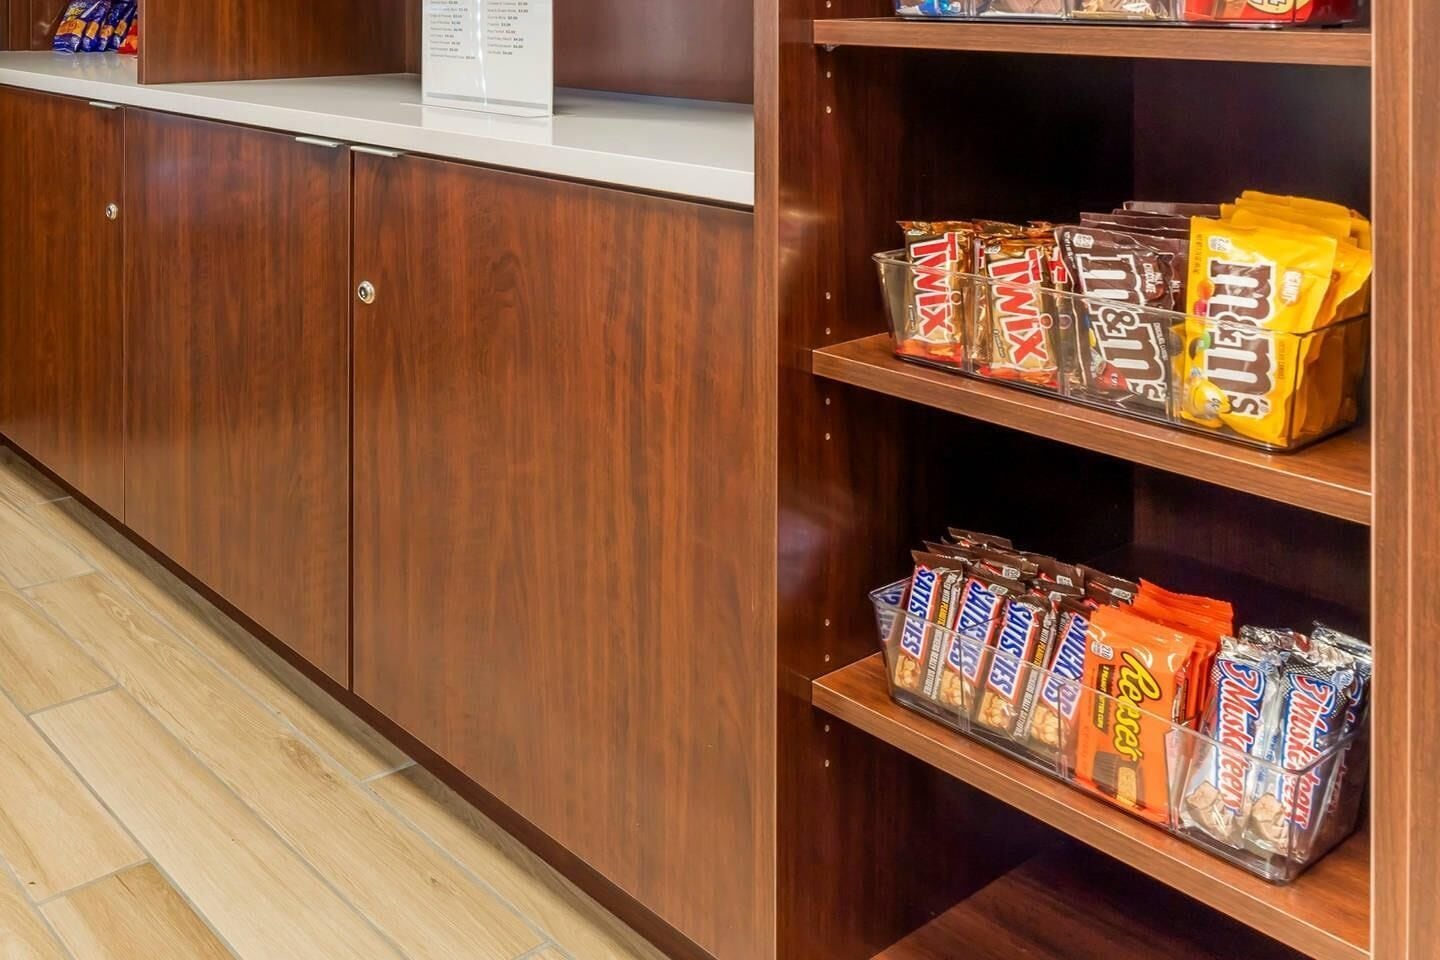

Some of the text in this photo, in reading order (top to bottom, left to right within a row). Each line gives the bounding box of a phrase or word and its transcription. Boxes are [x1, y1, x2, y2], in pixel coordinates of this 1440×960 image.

[911, 232, 961, 338] Twix
[988, 248, 1054, 365] Twix
[1207, 257, 1277, 417] m&m's
[1114, 651, 1162, 762] Reese's
